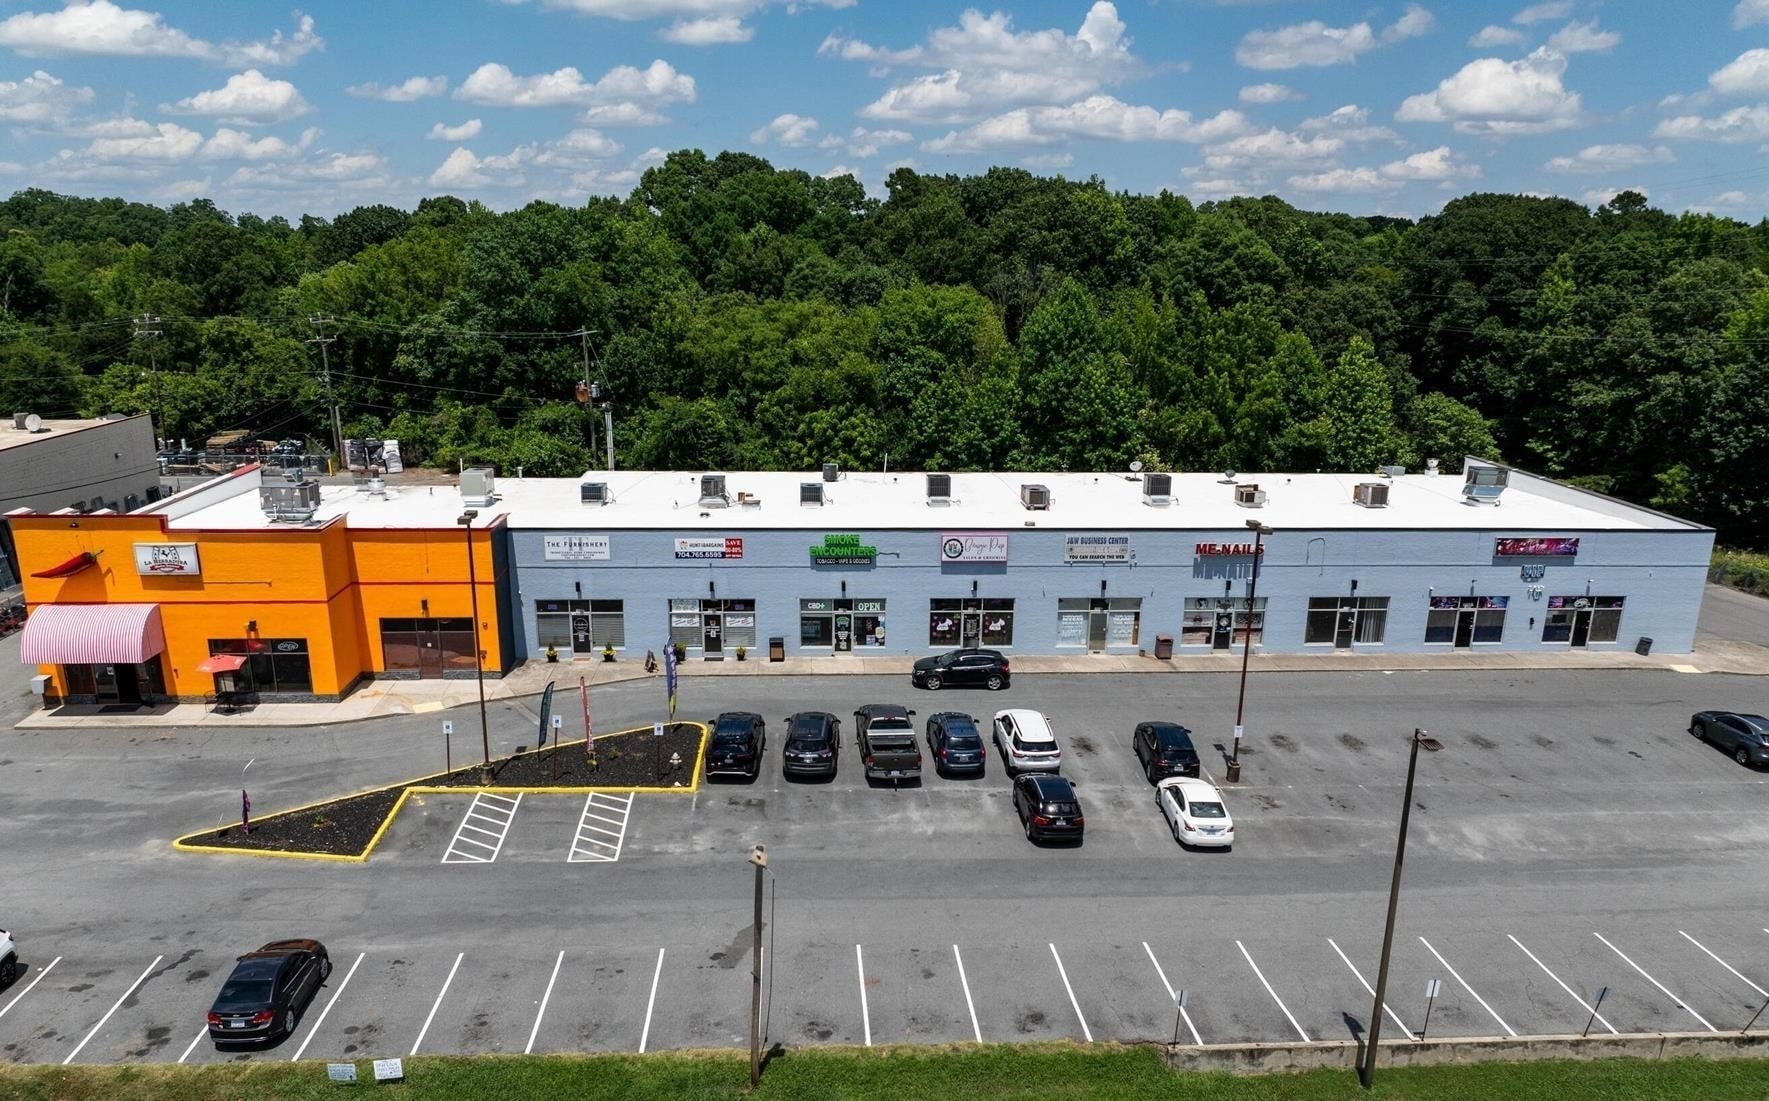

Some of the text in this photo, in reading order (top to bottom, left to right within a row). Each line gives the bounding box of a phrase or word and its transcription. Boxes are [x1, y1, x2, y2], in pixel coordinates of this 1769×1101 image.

[825, 534, 860, 545] SMOKE
[1080, 537, 1107, 545] BUSINESS
[1107, 537, 1129, 545] CENTER
[809, 546, 877, 556] ENCOUNTERS
[1195, 543, 1265, 555] ME-NAILS
[858, 602, 881, 611] OPEN
